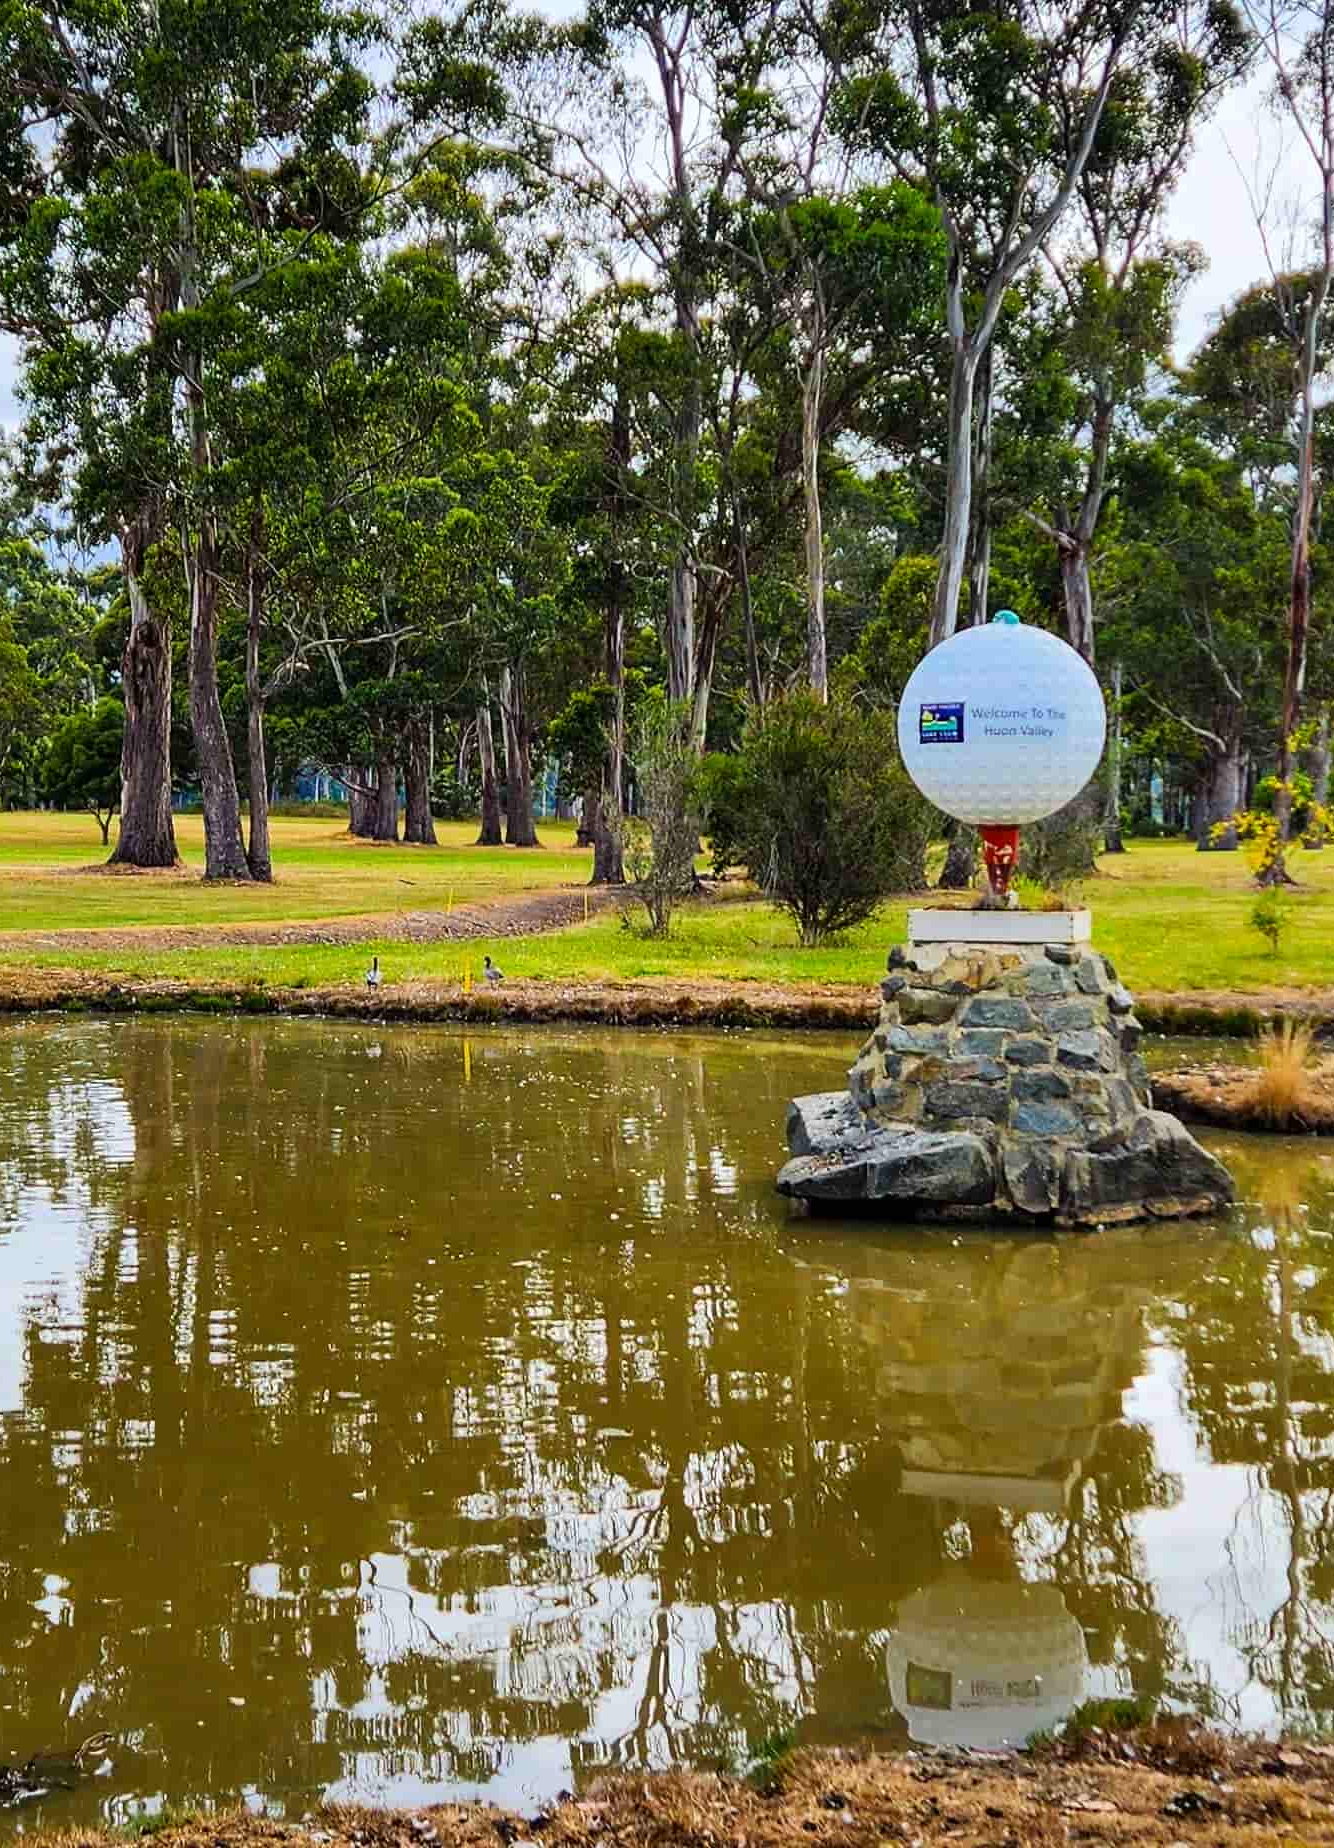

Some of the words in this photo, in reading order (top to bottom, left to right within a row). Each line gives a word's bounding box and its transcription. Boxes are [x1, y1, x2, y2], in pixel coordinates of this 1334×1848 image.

[971, 707, 1027, 719] Welcome
[1031, 707, 1044, 719] To
[1047, 708, 1067, 720] The
[984, 725, 1017, 736] Huon
[1019, 725, 1054, 738] Valley
